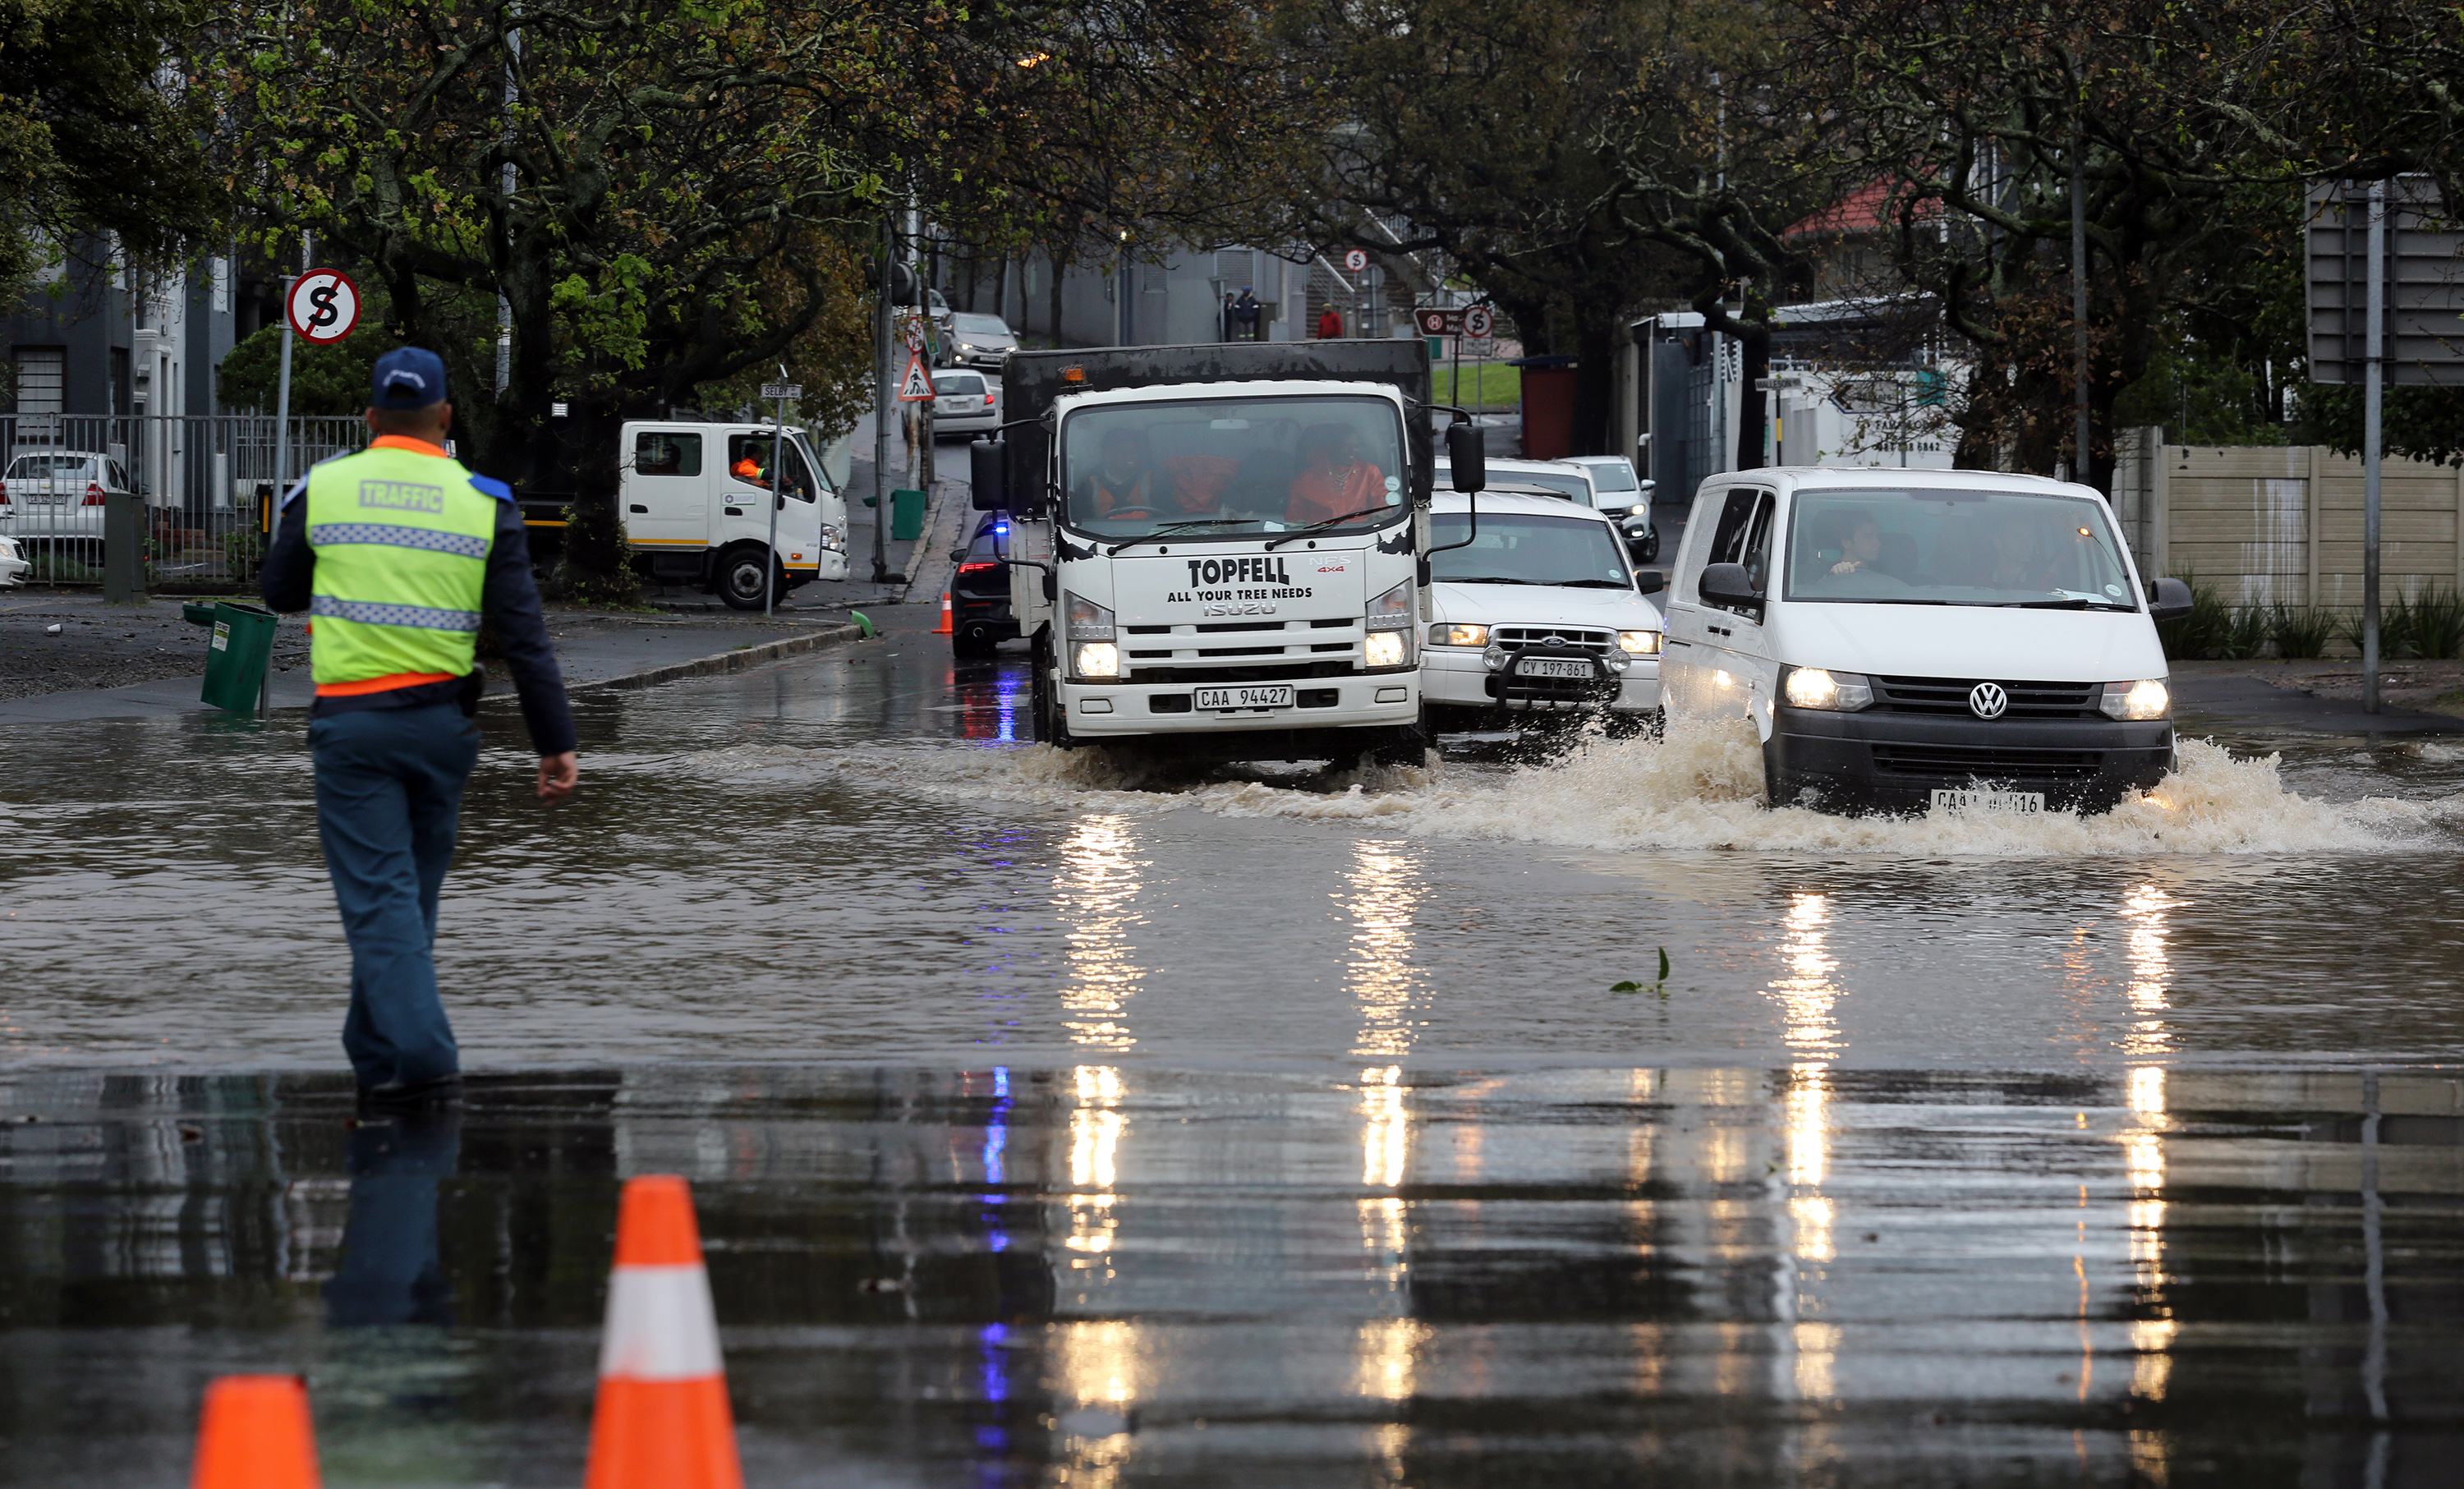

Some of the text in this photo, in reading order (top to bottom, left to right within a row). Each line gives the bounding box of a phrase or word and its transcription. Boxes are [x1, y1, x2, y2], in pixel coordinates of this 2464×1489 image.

[308, 286, 339, 327] S
[765, 387, 788, 396] SELBY
[362, 482, 443, 511] TRAFFIC
[1188, 557, 1289, 589] TOPFELL
[1167, 587, 1312, 603] ALL YOUR TREE NEEDS
[1203, 601, 1276, 617] ISUZU
[1523, 661, 1587, 677] CY 197-861
[1202, 688, 1287, 706] CAA 94427
